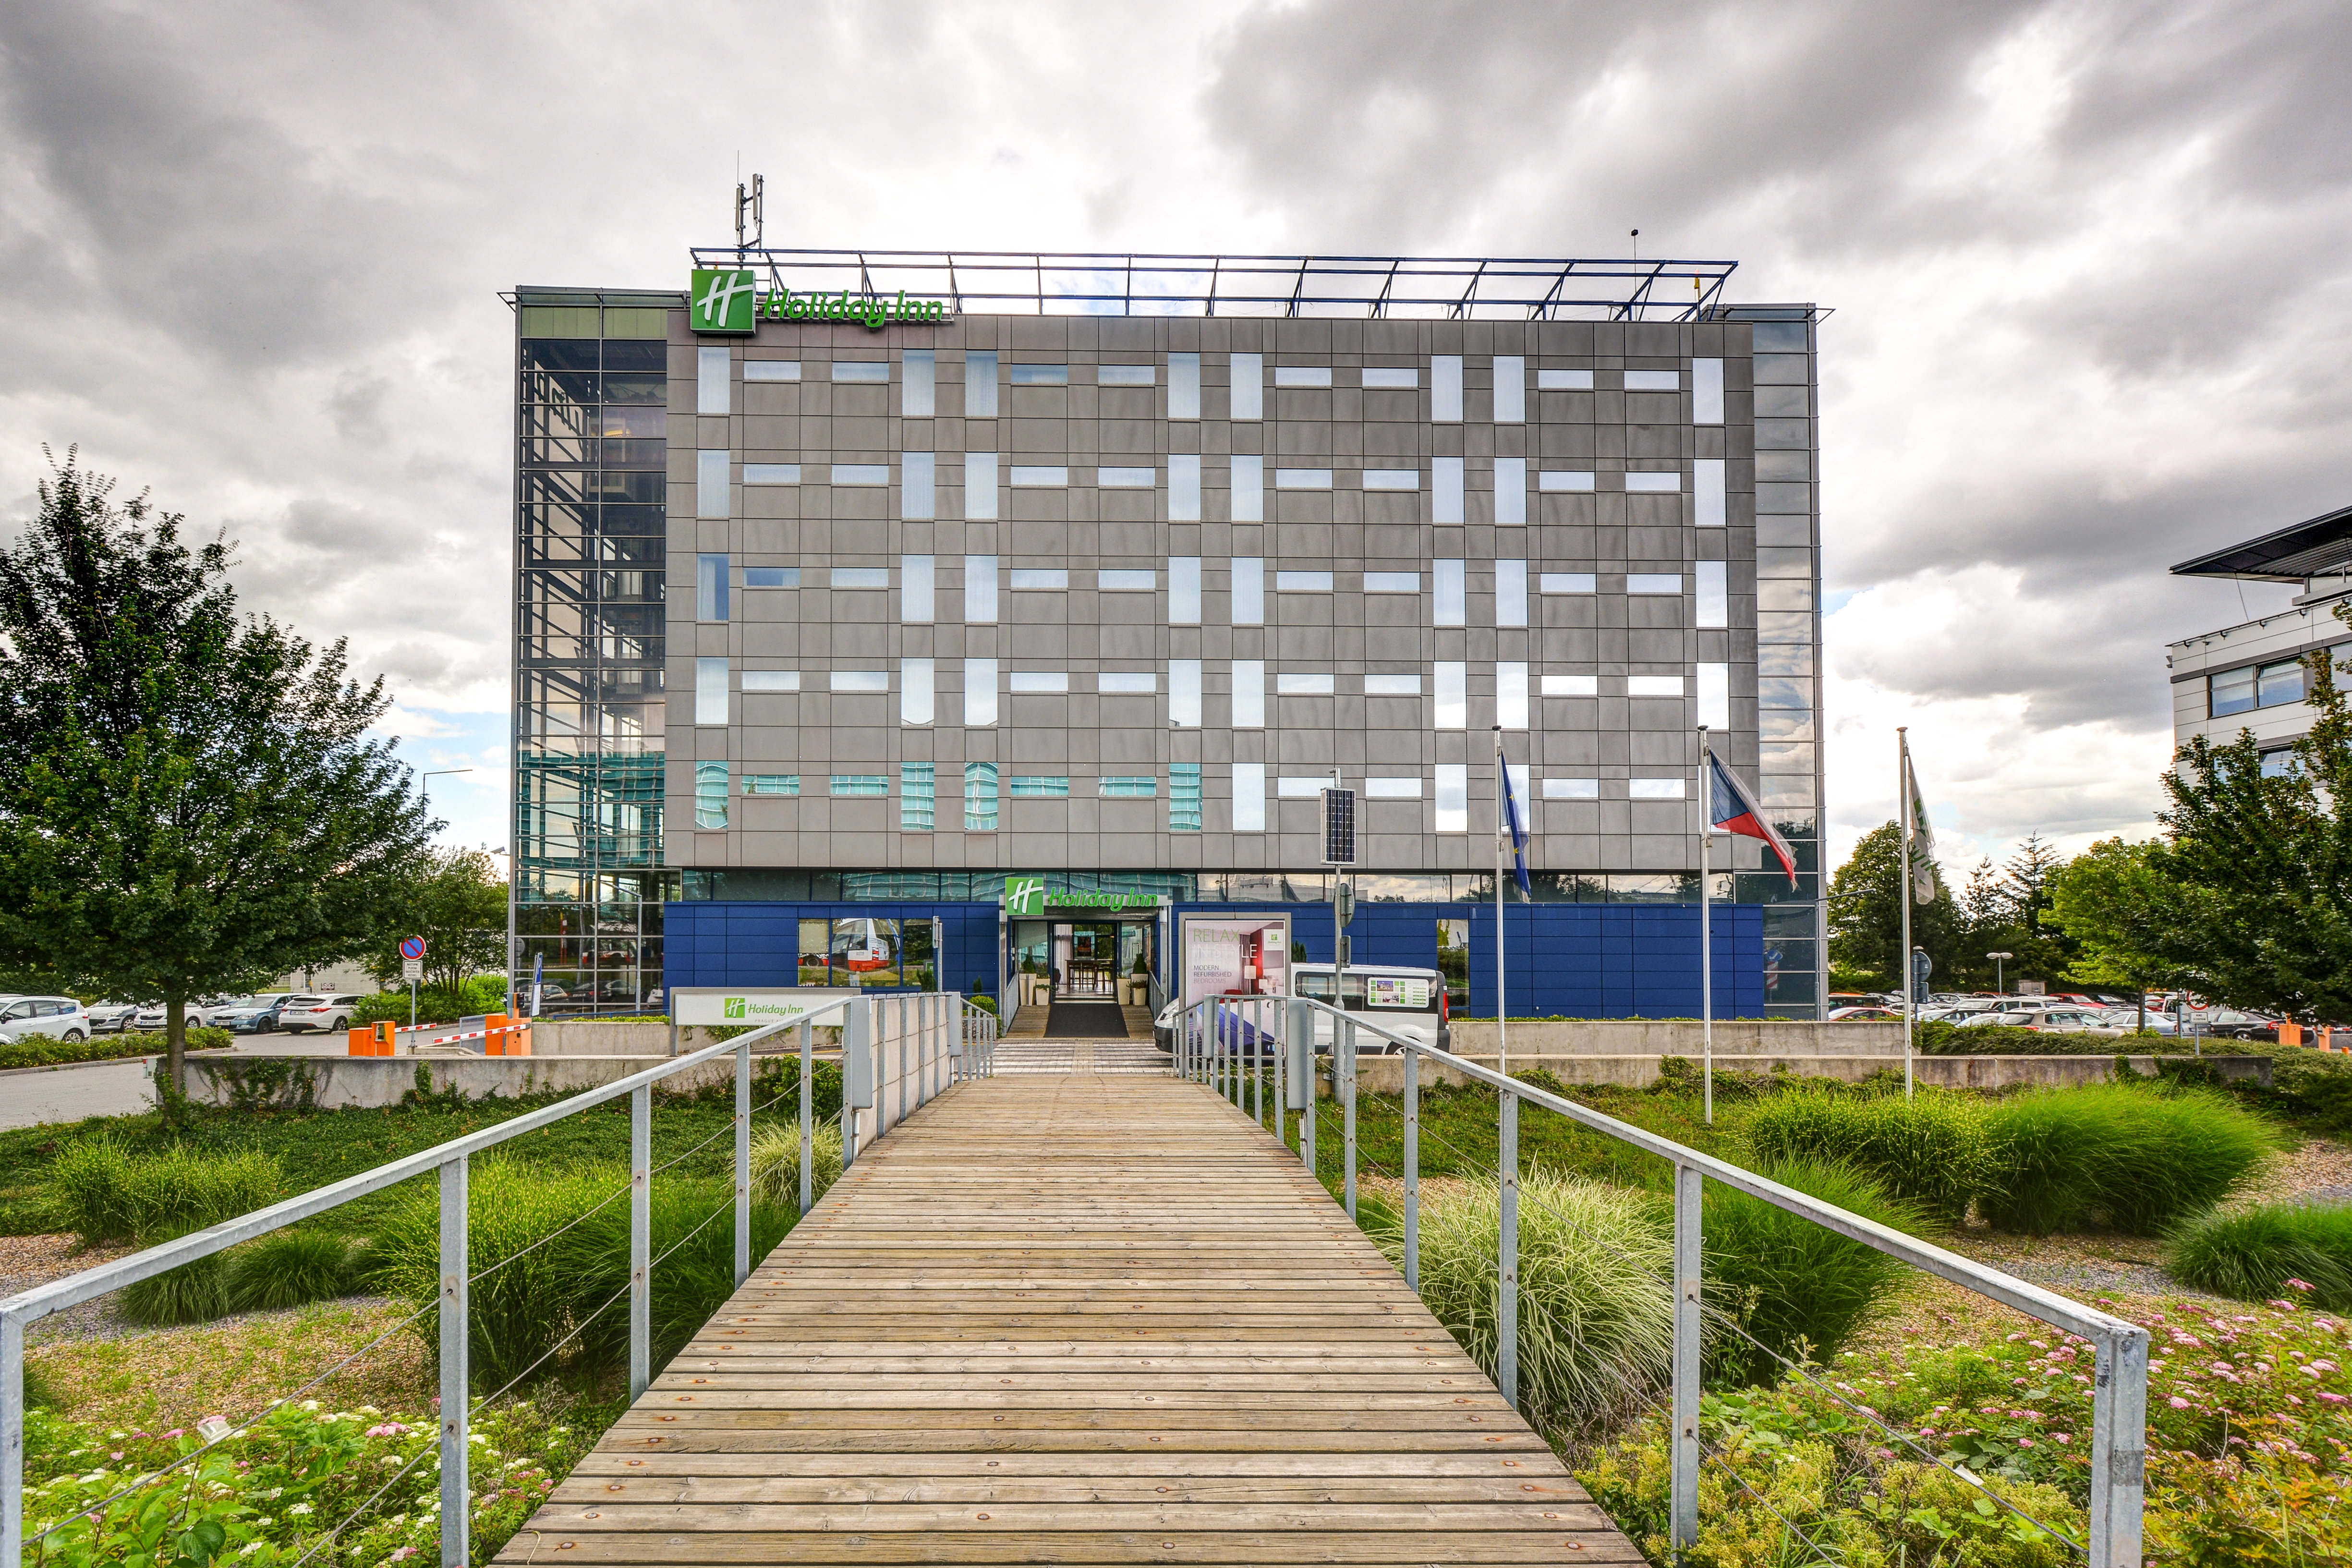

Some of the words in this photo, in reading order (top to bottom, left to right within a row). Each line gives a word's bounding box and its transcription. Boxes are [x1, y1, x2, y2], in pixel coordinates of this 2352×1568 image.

[762, 288, 889, 328] Holiday
[894, 290, 944, 321] Inn
[1048, 887, 1125, 912] Holiday
[1128, 887, 1158, 907] Inn
[1193, 929, 1240, 942] RELAX
[1194, 944, 1208, 958] IN
[1213, 944, 1257, 958] STYLE
[748, 1004, 787, 1016] Holiday
[788, 1004, 803, 1013] Inn
